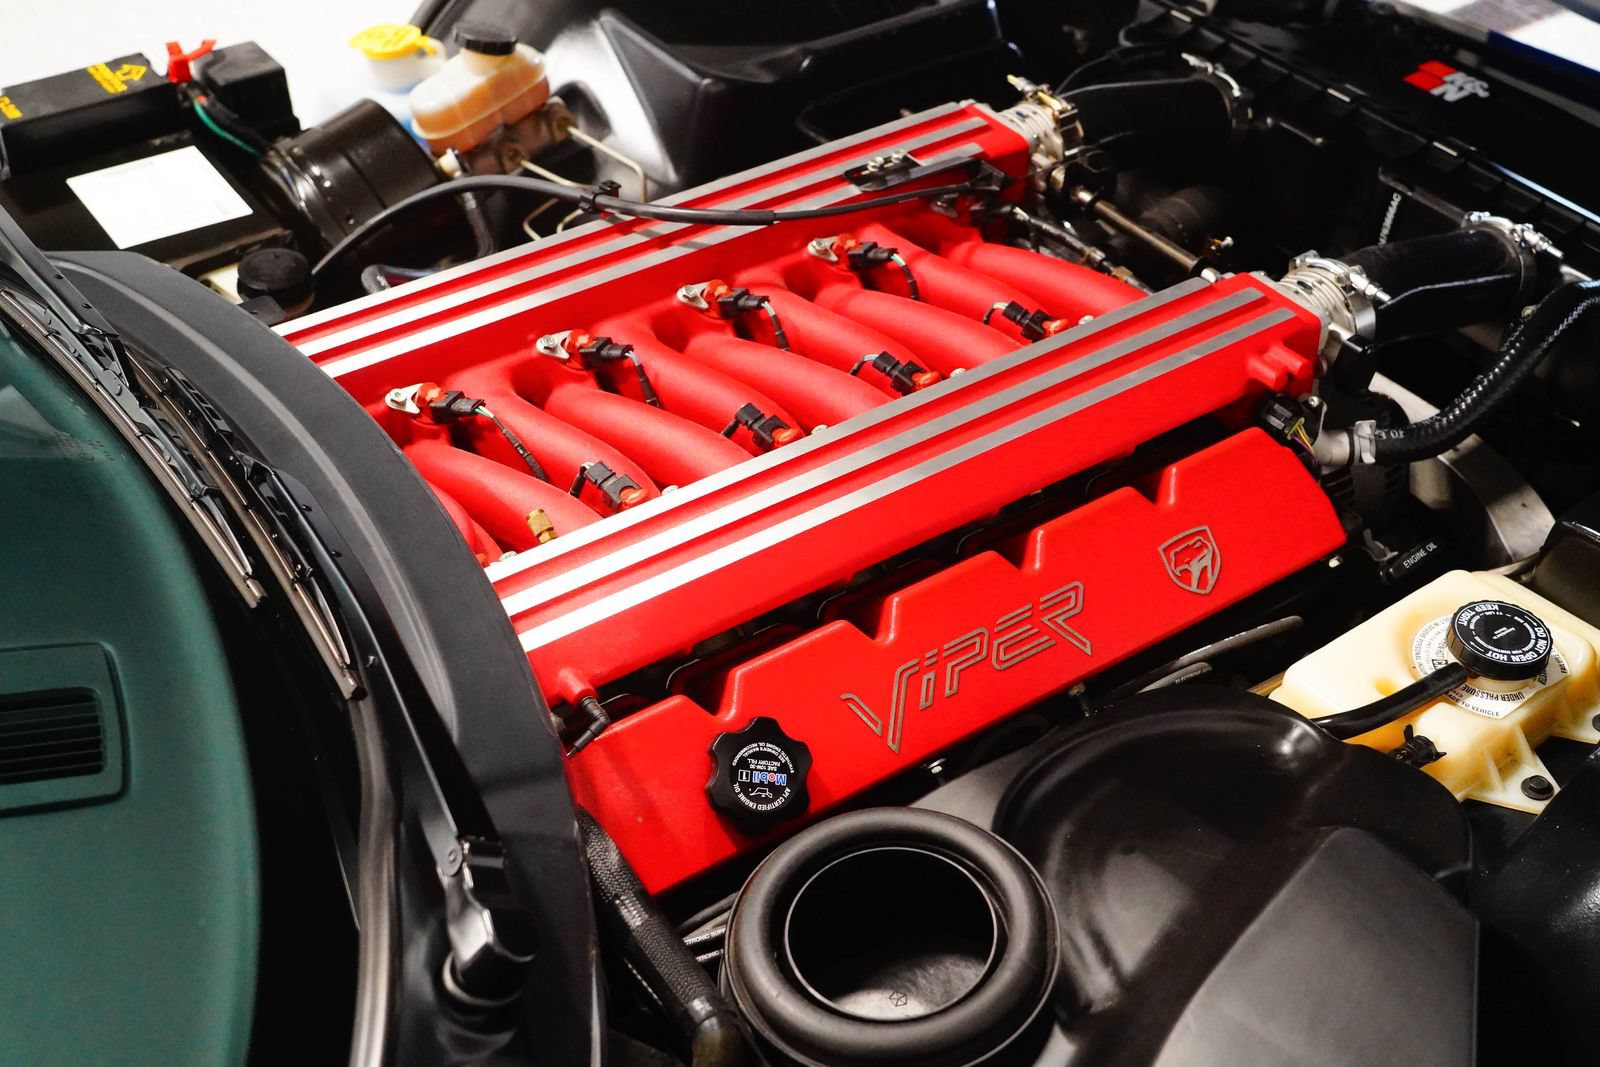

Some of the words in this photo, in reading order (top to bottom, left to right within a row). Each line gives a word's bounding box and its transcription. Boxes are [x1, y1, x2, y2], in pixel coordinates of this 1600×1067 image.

[1403, 549, 1427, 568] ENGINE
[1426, 542, 1437, 552] OIL
[1474, 603, 1499, 613] KEEP
[1457, 610, 1476, 627] TIGHT
[1534, 627, 1546, 638] DO
[1535, 638, 1547, 654] NOT
[1485, 651, 1508, 661] HOT
[1510, 651, 1538, 662] OPEN
[1461, 683, 1499, 701] PRESSURE
[1500, 690, 1525, 702] UNDER
[1471, 705, 1500, 717] VEHICLE
[752, 771, 787, 786] Mobil
[733, 782, 741, 793] OIL
[782, 787, 791, 799] API
[738, 792, 757, 809] ENGINE
[757, 796, 785, 811] CERTIFIED
